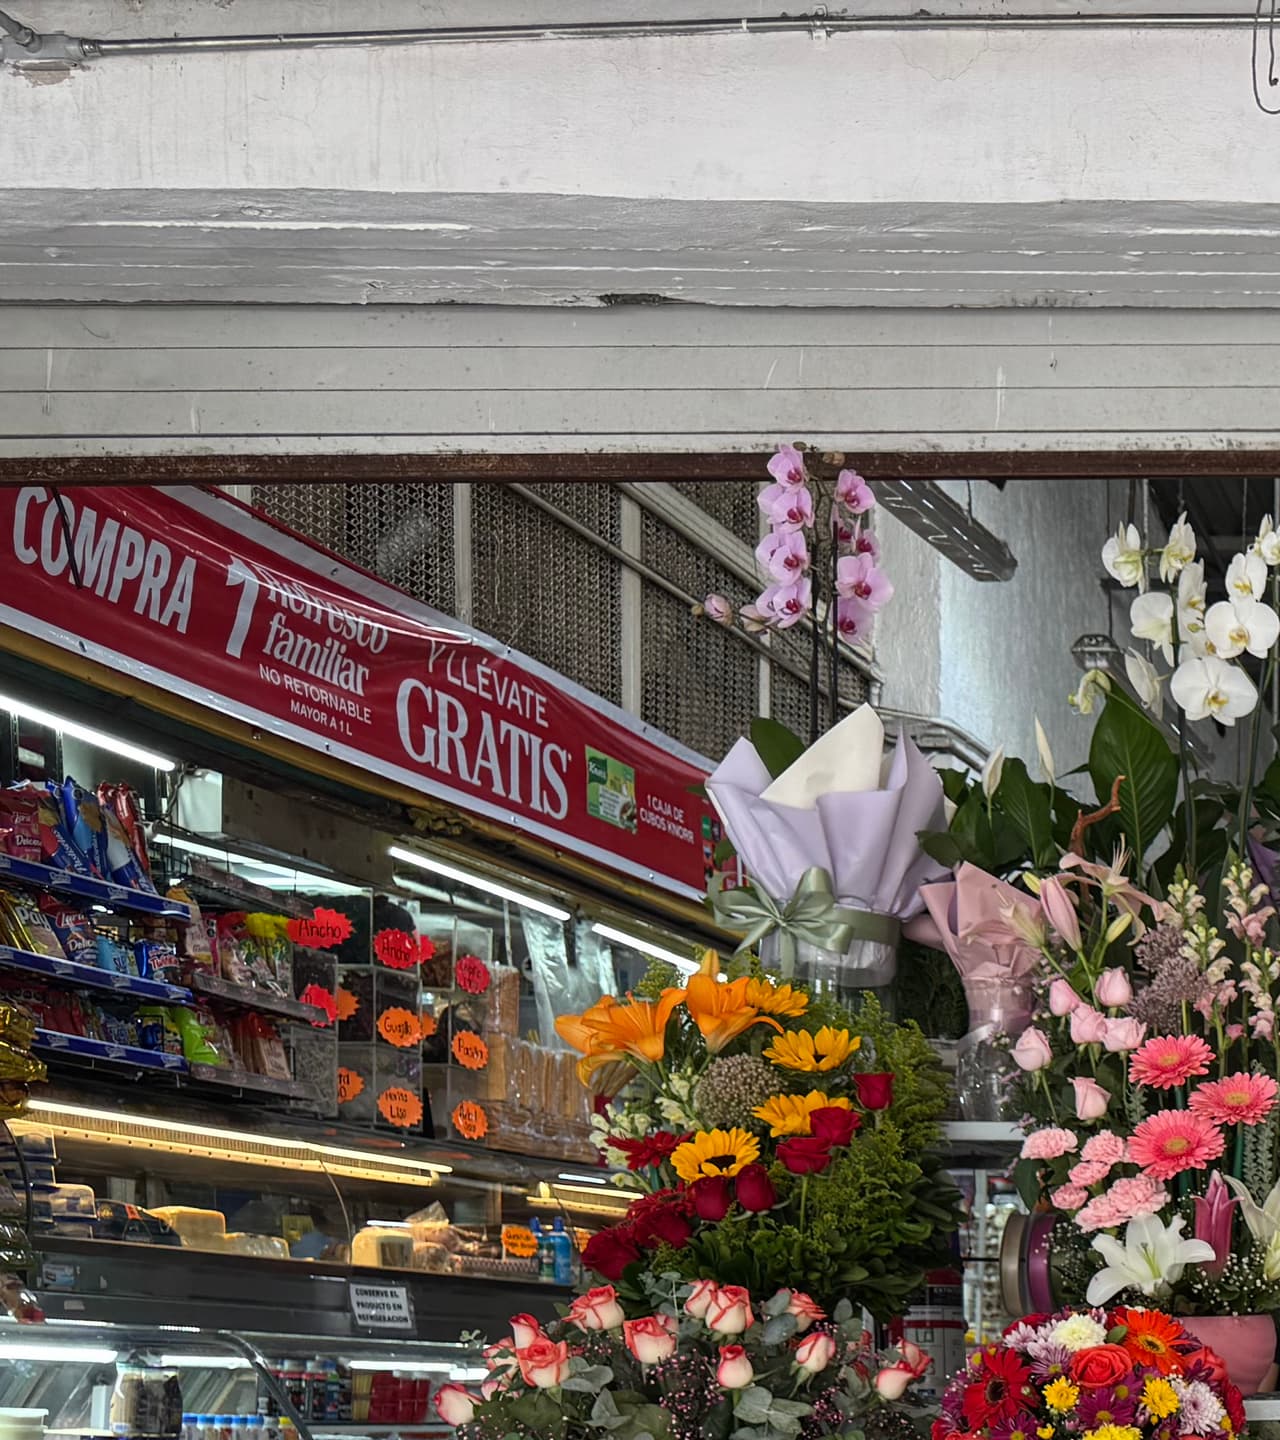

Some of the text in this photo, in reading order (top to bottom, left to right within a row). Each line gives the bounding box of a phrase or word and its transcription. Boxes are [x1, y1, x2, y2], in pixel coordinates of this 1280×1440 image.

[14, 487, 196, 634] COMPRA
[226, 554, 260, 659] 1
[252, 564, 389, 654] Refresco
[262, 612, 370, 697] familiar
[428, 640, 549, 729] Y LLÉVATE
[259, 663, 373, 725] NO RETORNABLE
[290, 699, 353, 737] MAYOR A 1 L
[640, 807, 667, 832] CUBOS
[652, 796, 673, 818] CAJA
[673, 806, 685, 824] DE
[299, 919, 342, 940] Ancho
